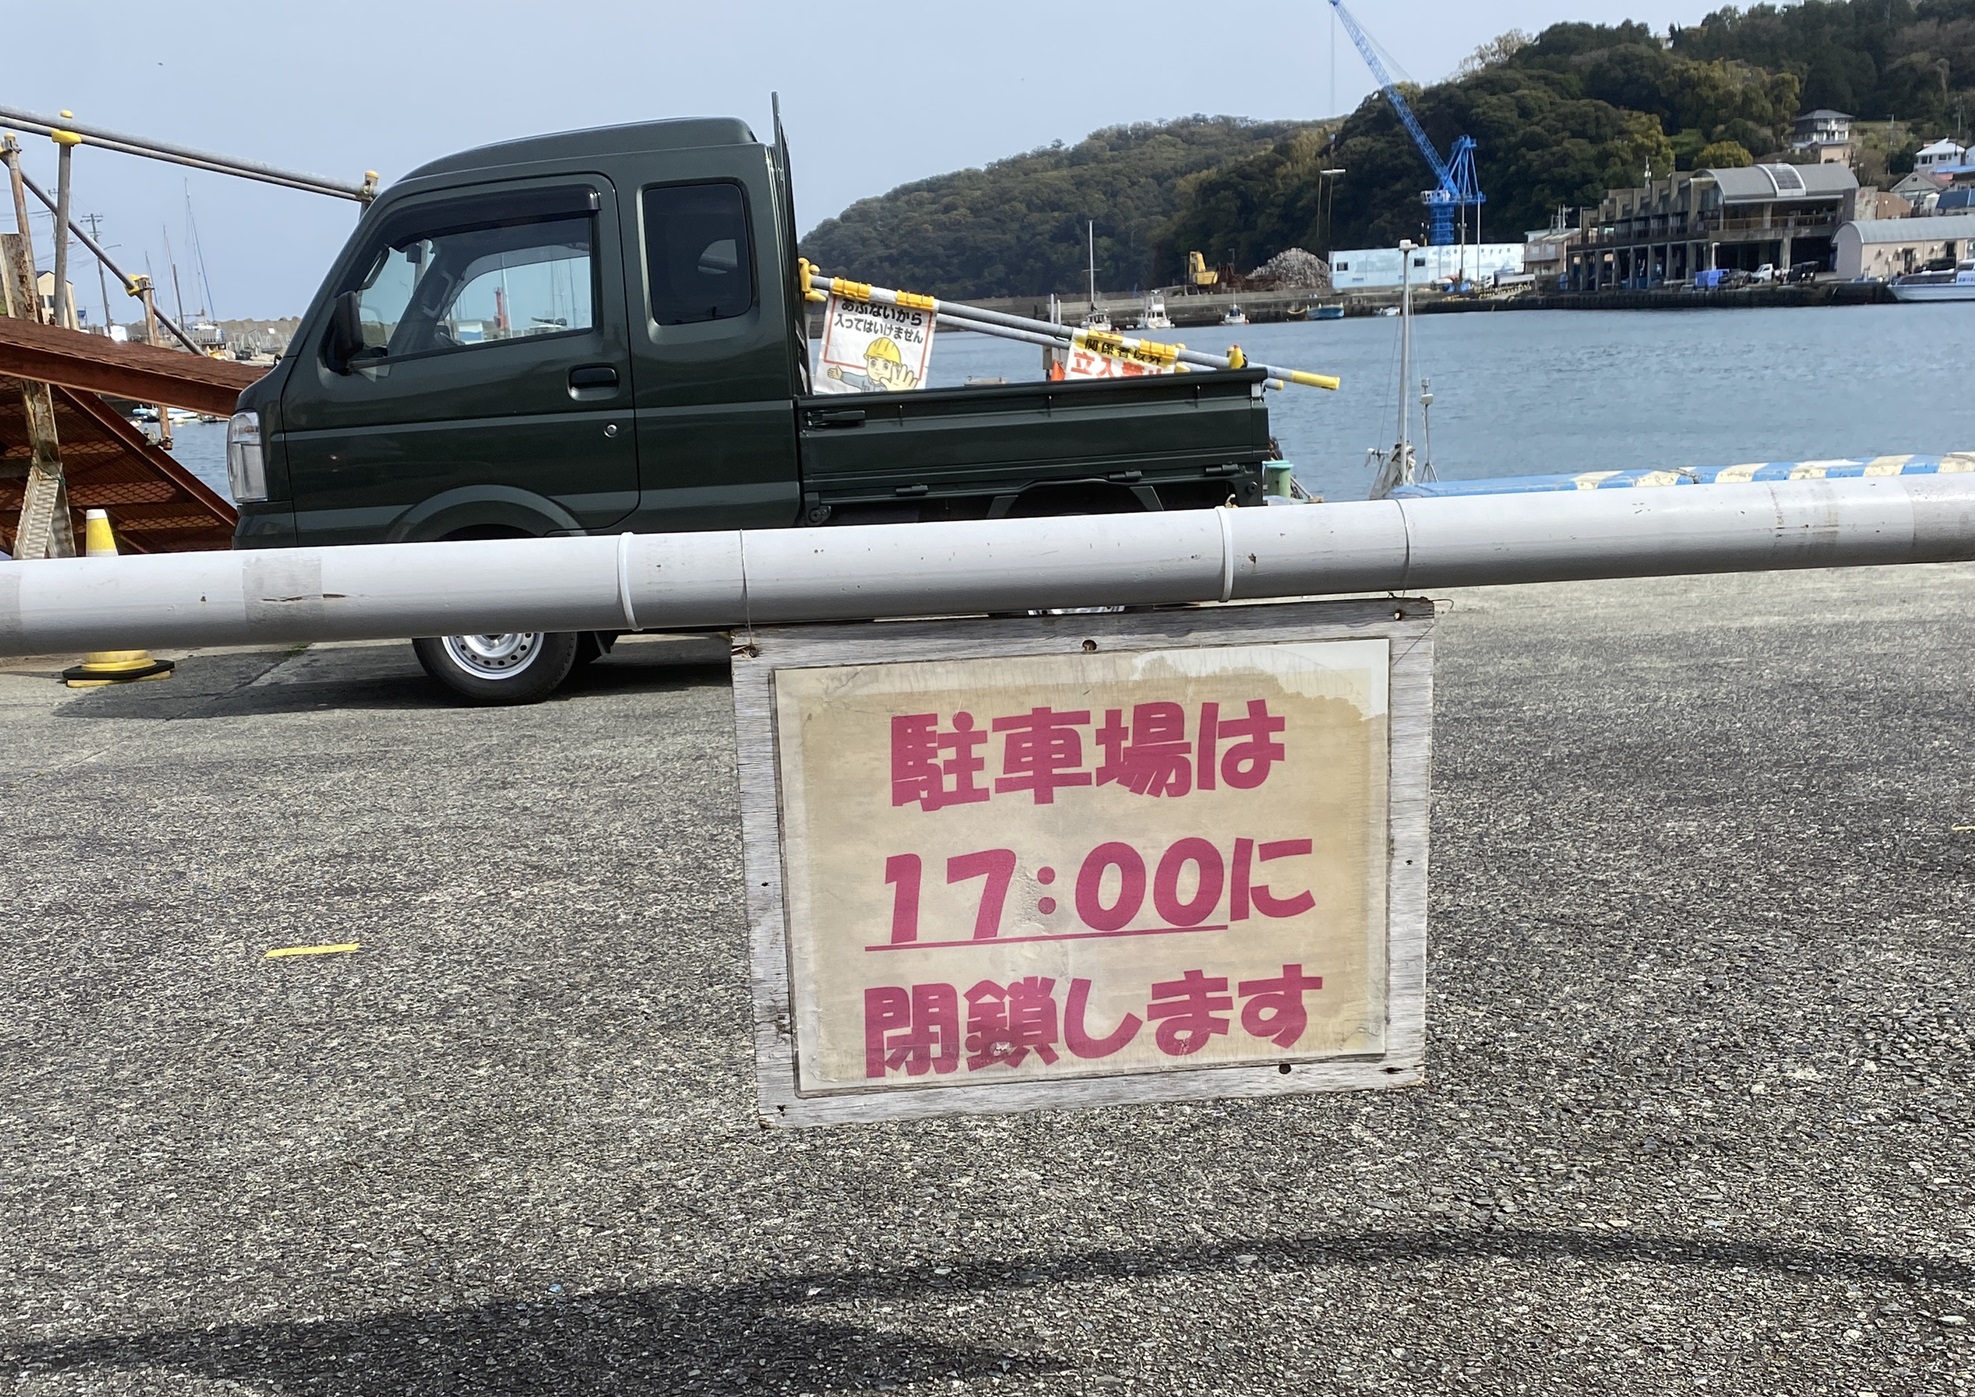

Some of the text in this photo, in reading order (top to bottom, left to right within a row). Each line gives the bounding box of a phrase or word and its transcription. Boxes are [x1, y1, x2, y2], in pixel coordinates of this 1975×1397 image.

[834, 313, 924, 344] 入ってはいけません
[1070, 351, 1162, 378] 立入禁
[891, 699, 1285, 812] 駐車場は
[884, 837, 1316, 945] 17:00に
[864, 963, 1323, 1078] 閉鎖します
